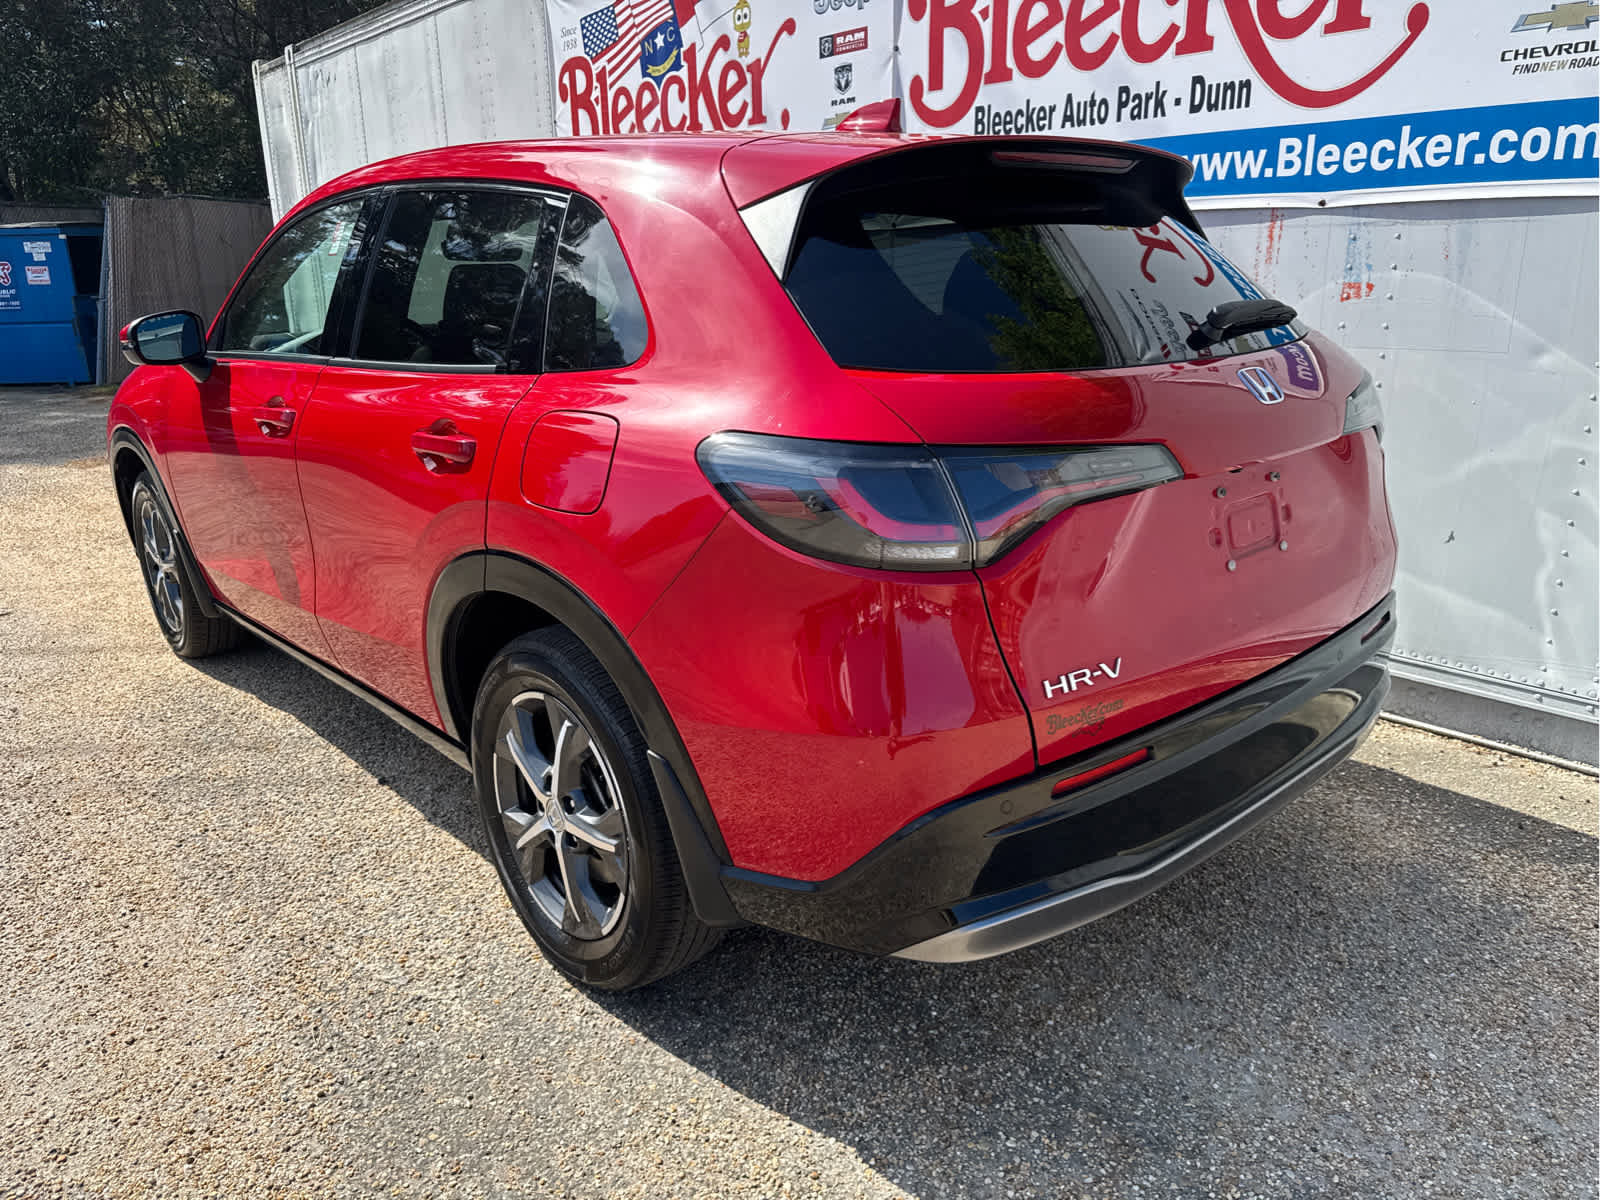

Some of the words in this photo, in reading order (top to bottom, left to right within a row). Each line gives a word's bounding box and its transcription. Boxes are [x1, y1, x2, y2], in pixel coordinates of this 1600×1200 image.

[560, 27, 577, 39] Since
[836, 31, 865, 45] RAM
[562, 40, 578, 52] 1938
[831, 97, 856, 107] RAM
[973, 98, 1057, 136] Bleecker
[1060, 90, 1110, 129] Auto
[1115, 80, 1168, 123] Park
[1188, 74, 1252, 114] Dunn
[1042, 656, 1123, 699] HR-V
